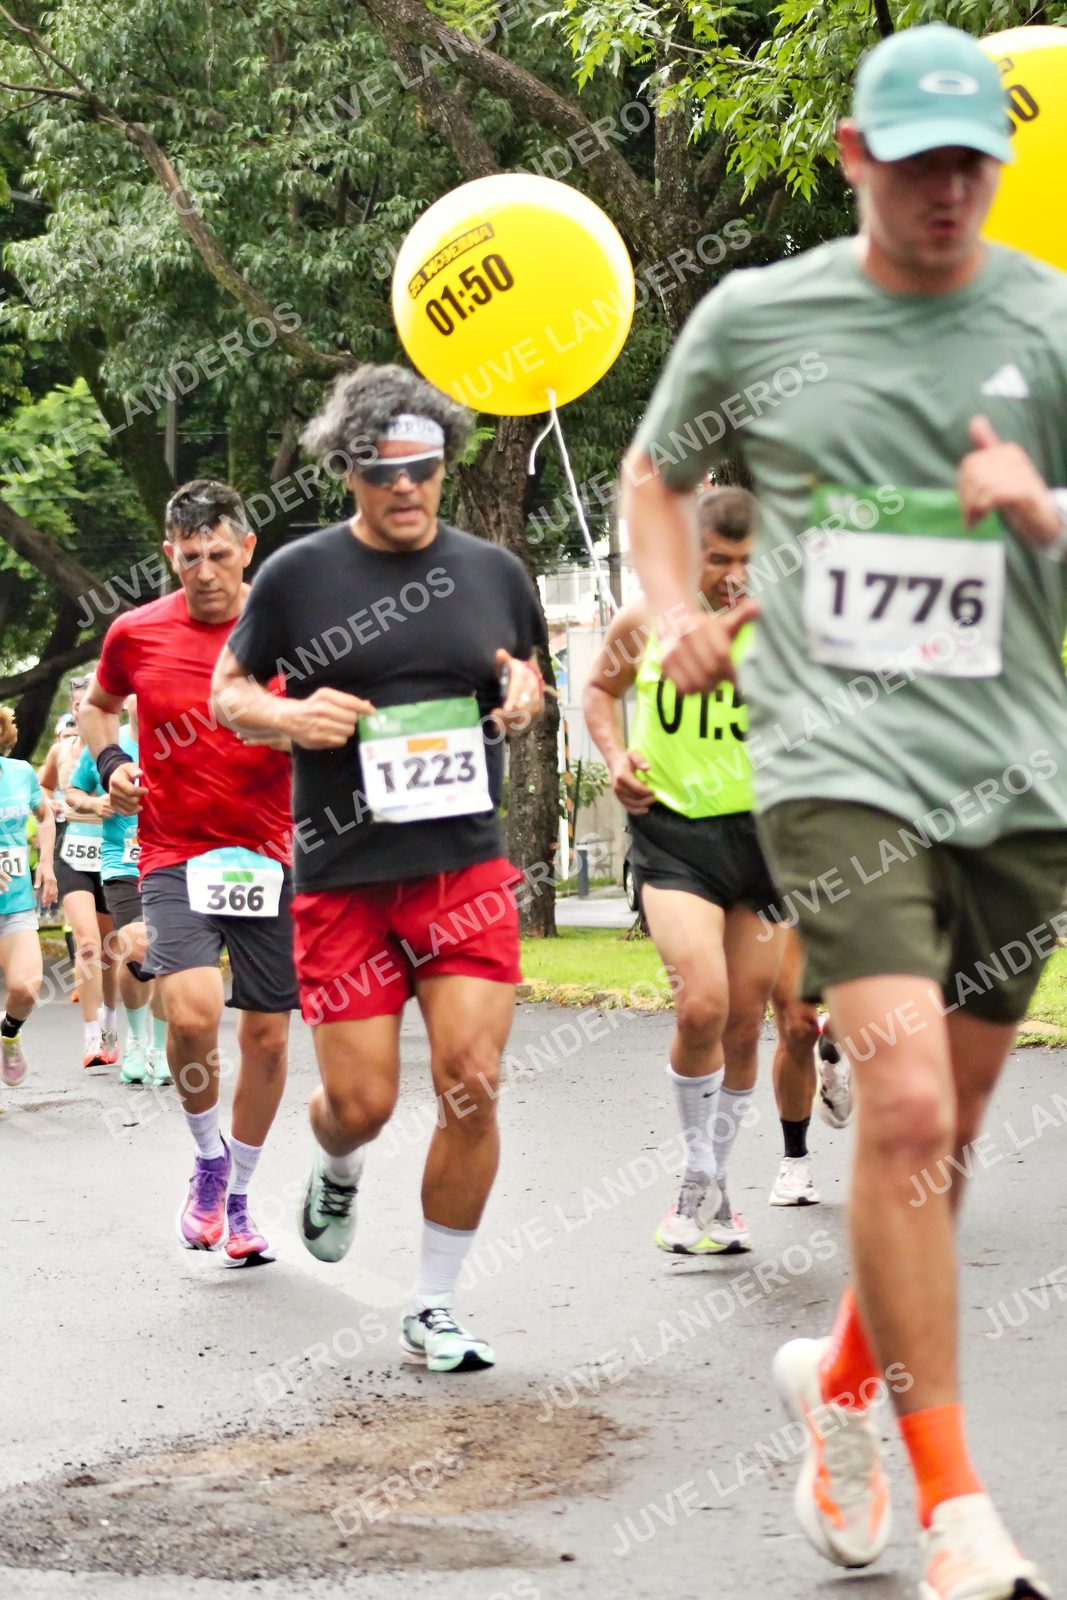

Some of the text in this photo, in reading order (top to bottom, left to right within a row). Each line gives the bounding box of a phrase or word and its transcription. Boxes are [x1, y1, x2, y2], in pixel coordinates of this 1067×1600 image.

[426, 254, 514, 336] 01:50
[828, 569, 985, 627] 1776
[377, 751, 476, 793] 1223
[206, 884, 264, 911] 366
